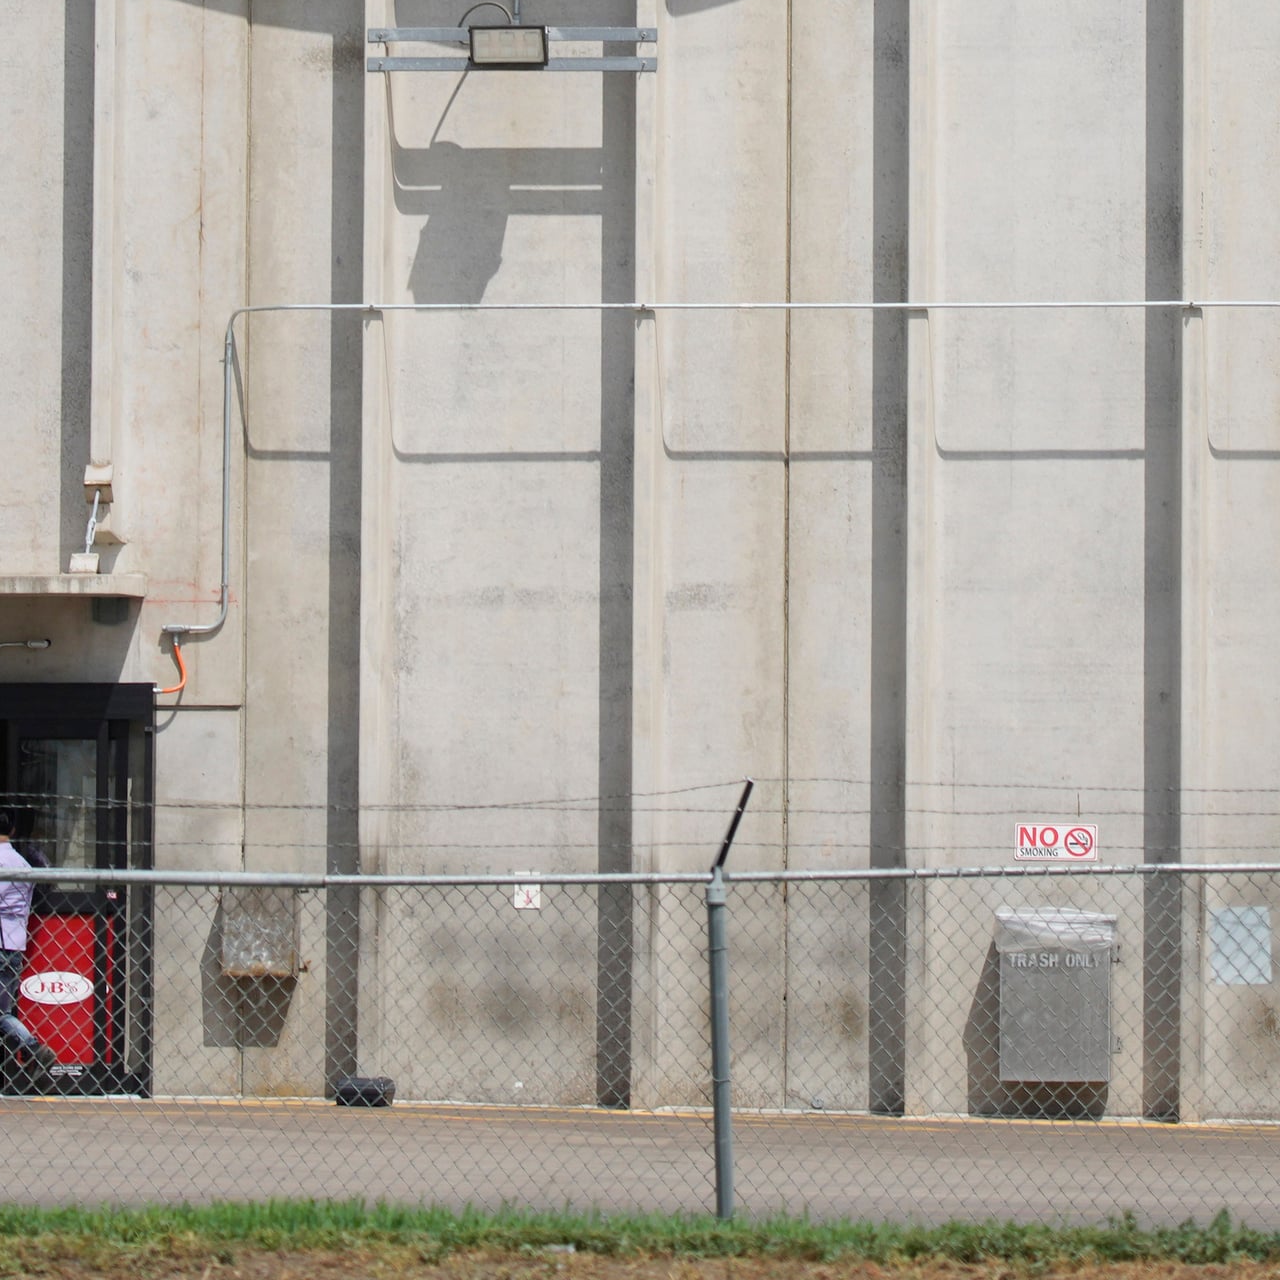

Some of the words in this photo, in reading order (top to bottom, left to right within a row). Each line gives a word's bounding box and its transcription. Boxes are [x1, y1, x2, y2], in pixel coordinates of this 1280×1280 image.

[1019, 826, 1059, 847] NO
[1019, 847, 1059, 858] SMOKING
[1009, 952, 1060, 968] TRASH
[1065, 952, 1102, 968] ONLY
